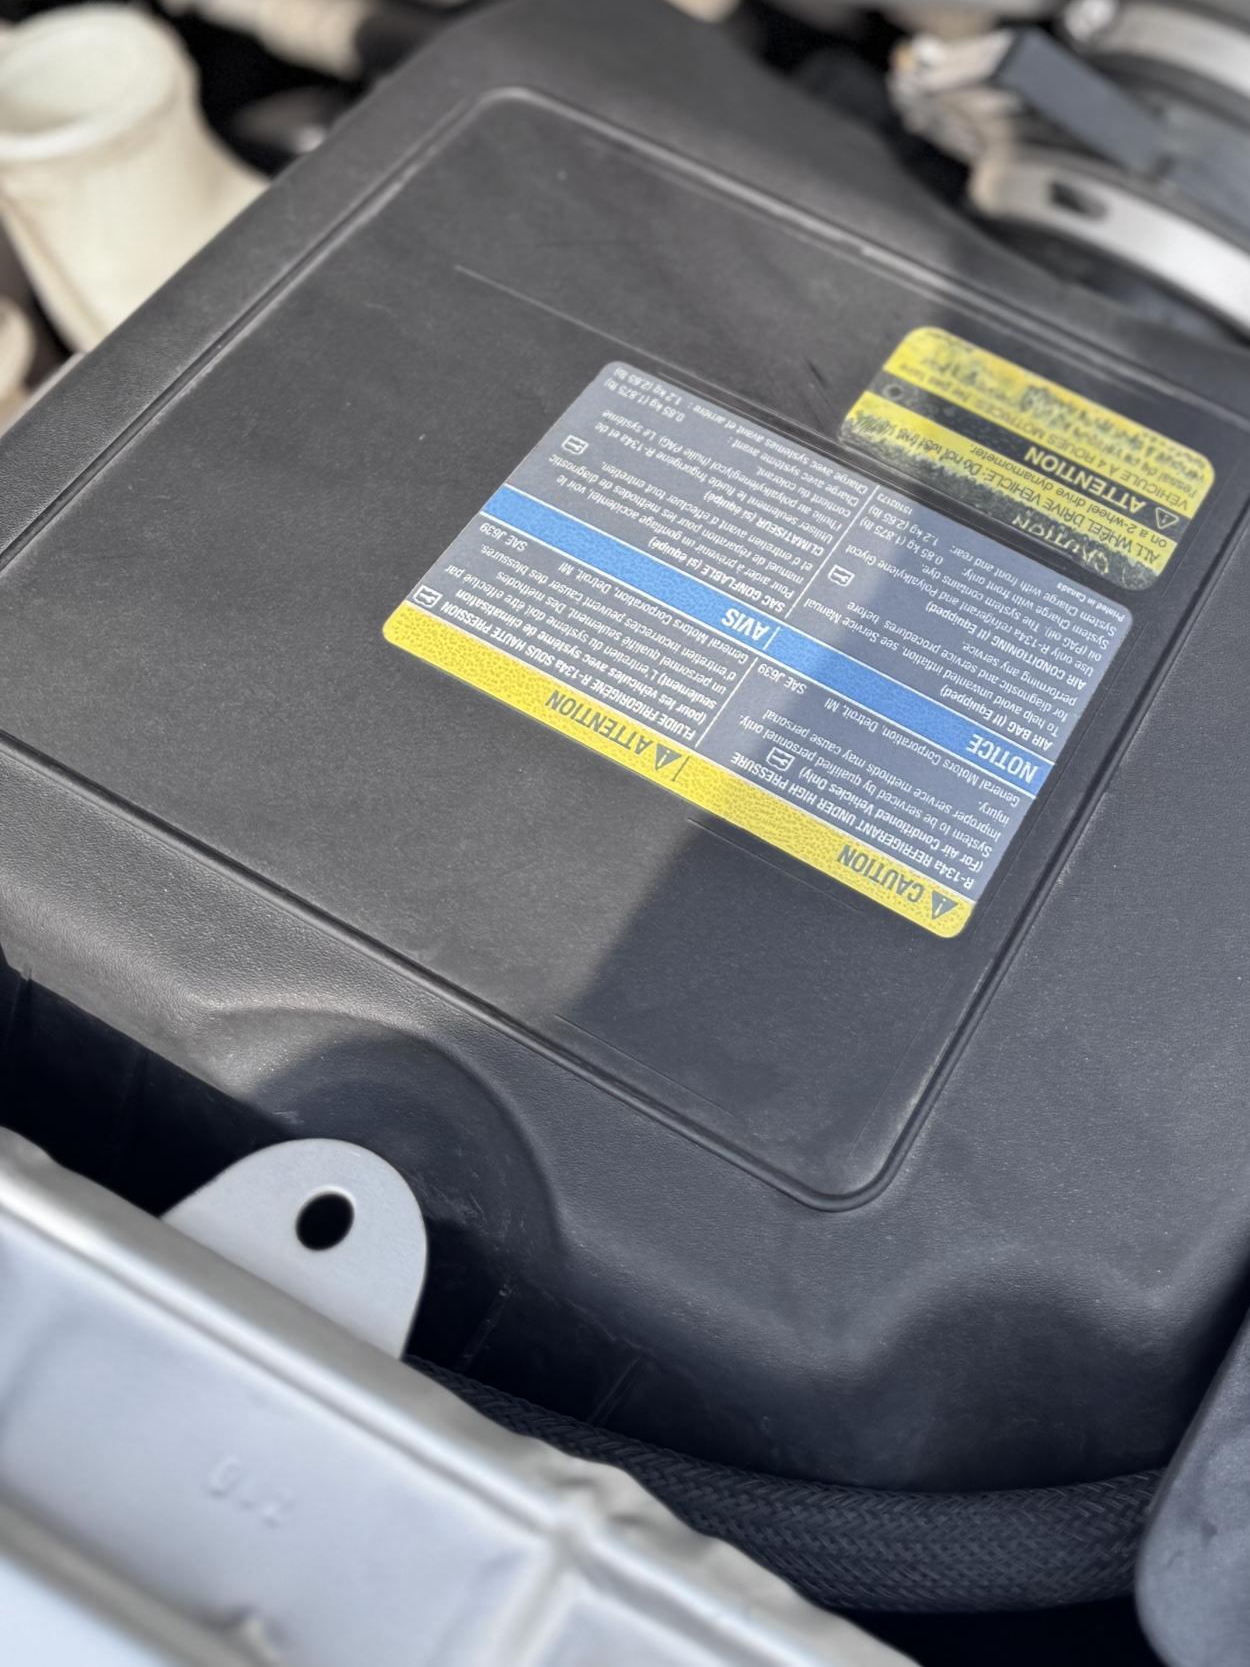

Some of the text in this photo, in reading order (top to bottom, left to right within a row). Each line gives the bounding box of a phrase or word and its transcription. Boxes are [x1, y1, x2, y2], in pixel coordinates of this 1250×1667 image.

[1045, 433, 1097, 464] ROUES
[1097, 458, 1108, 468] 4
[966, 442, 1056, 492] dynamometer.
[1022, 445, 1148, 515] ATTENTION
[979, 467, 1044, 505] VEHICLE:
[1053, 487, 1087, 508] drive
[1118, 469, 1191, 511] VÉHICULE
[739, 509, 757, 522] (si
[867, 504, 939, 546] 1.2 kg (2.65 lb)
[1040, 497, 1086, 527] DRIVE
[1086, 503, 1138, 534] 2-wheel
[478, 521, 528, 552] SAE J639
[755, 516, 824, 556] CLIMATISEUR
[858, 515, 944, 565] 0.85 kg (1.875 lb)
[1082, 518, 1135, 552] WHEEL
[1138, 528, 1148, 537] a
[1149, 534, 1168, 548] on
[480, 543, 529, 576] blessures.
[557, 561, 574, 576] MI
[685, 556, 703, 570] (si
[1131, 542, 1160, 564] ALL
[443, 564, 465, 578] par
[527, 568, 549, 584] des
[699, 563, 762, 601] GONFLABLE
[544, 595, 567, 614] Des
[547, 579, 584, 604] causer
[613, 586, 673, 625] Corporation,
[760, 594, 786, 613] SAC
[948, 544, 1117, 636] System Charge with front and rear:
[440, 600, 492, 633] PRESSION
[454, 588, 523, 628] climatisation
[523, 604, 546, 621] doit
[567, 606, 622, 641] seulement.
[581, 596, 626, 623] peuvent
[802, 597, 842, 624] Manual
[960, 567, 1109, 650] System Charge with front only:
[489, 626, 527, 651] HAUTE
[521, 623, 538, 636] de
[623, 617, 681, 653] incorrectes
[671, 618, 709, 644] Motors
[720, 607, 770, 641] AVIS
[841, 616, 880, 643] Service
[524, 644, 555, 666] SOUS
[587, 637, 604, 650] du
[706, 637, 749, 665] General
[879, 635, 899, 651] see
[924, 600, 1087, 690] AIR CONDITIONING (If Equipped)
[554, 658, 592, 685] R-134a
[581, 653, 609, 672] avec
[658, 655, 713, 687] personnel
[846, 601, 1068, 722] for diagnostic and service procedures before
[961, 640, 1077, 706] performing any service.
[656, 671, 717, 709] seulement)
[710, 681, 726, 695] un
[756, 662, 807, 695] SAE J639
[941, 668, 994, 699] unwanted
[657, 693, 677, 710] les
[674, 703, 707, 725] (pour
[939, 683, 1053, 751] AIR BAG (If Equipped)
[992, 694, 1023, 715] avoid
[544, 689, 653, 755] ATTENTION
[657, 712, 696, 740] FLUIDE
[1022, 709, 1046, 729] help
[1046, 722, 1059, 738] To
[823, 697, 1020, 808] General Motors Corporation, Detroit, MI
[965, 733, 1038, 783] NOTICE
[738, 714, 992, 858] System to be serviced by qualified personnel only.
[761, 708, 1001, 842] Improper service methods may cause personal
[729, 751, 975, 890] R-134a REFRIGERANT UNDER HIGH PRESSURE
[797, 765, 983, 873] (For Air Conditioned Vehicles Only)
[977, 800, 1010, 827] injury.
[835, 844, 925, 903] CAUTION
